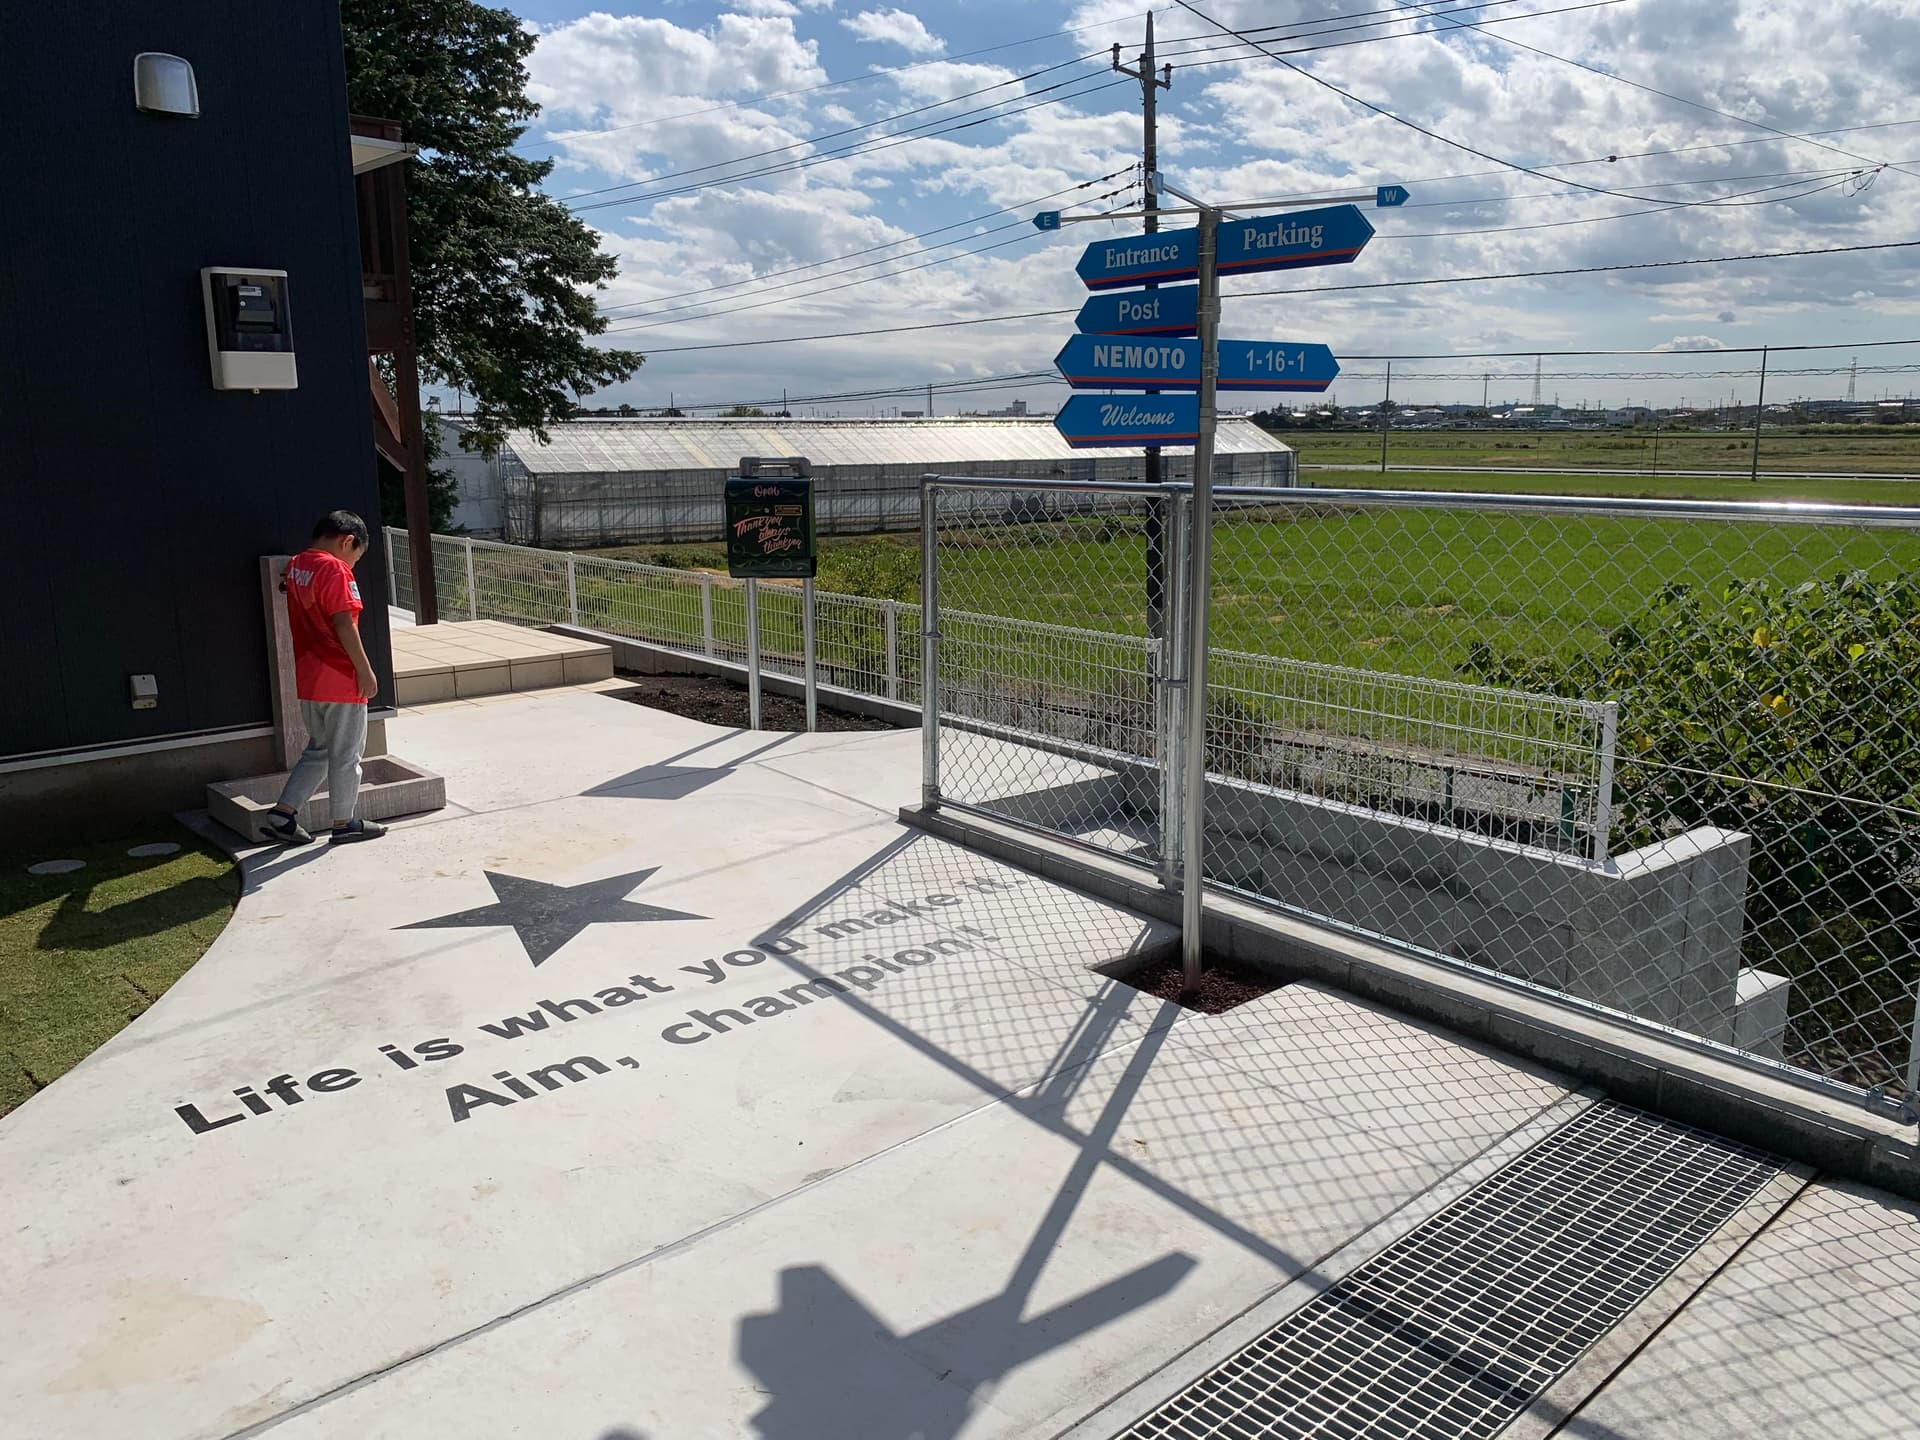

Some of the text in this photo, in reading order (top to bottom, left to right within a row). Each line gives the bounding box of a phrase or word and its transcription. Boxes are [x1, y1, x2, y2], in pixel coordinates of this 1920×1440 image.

[1384, 189, 1396, 202] W
[1044, 215, 1051, 227] E
[1243, 223, 1324, 250] Parking
[1105, 245, 1178, 269] Entrance
[1119, 299, 1160, 322] Post
[1093, 345, 1185, 369] NEMOTO
[1246, 350, 1305, 372] 1-16-1
[1100, 404, 1175, 427] Welcome
[174, 1068, 363, 1135] Life
[377, 1038, 465, 1070] is
[477, 974, 675, 1040] what
[678, 936, 810, 984] you
[813, 894, 962, 940] make
[445, 924, 1001, 1123] Aim, champion!
